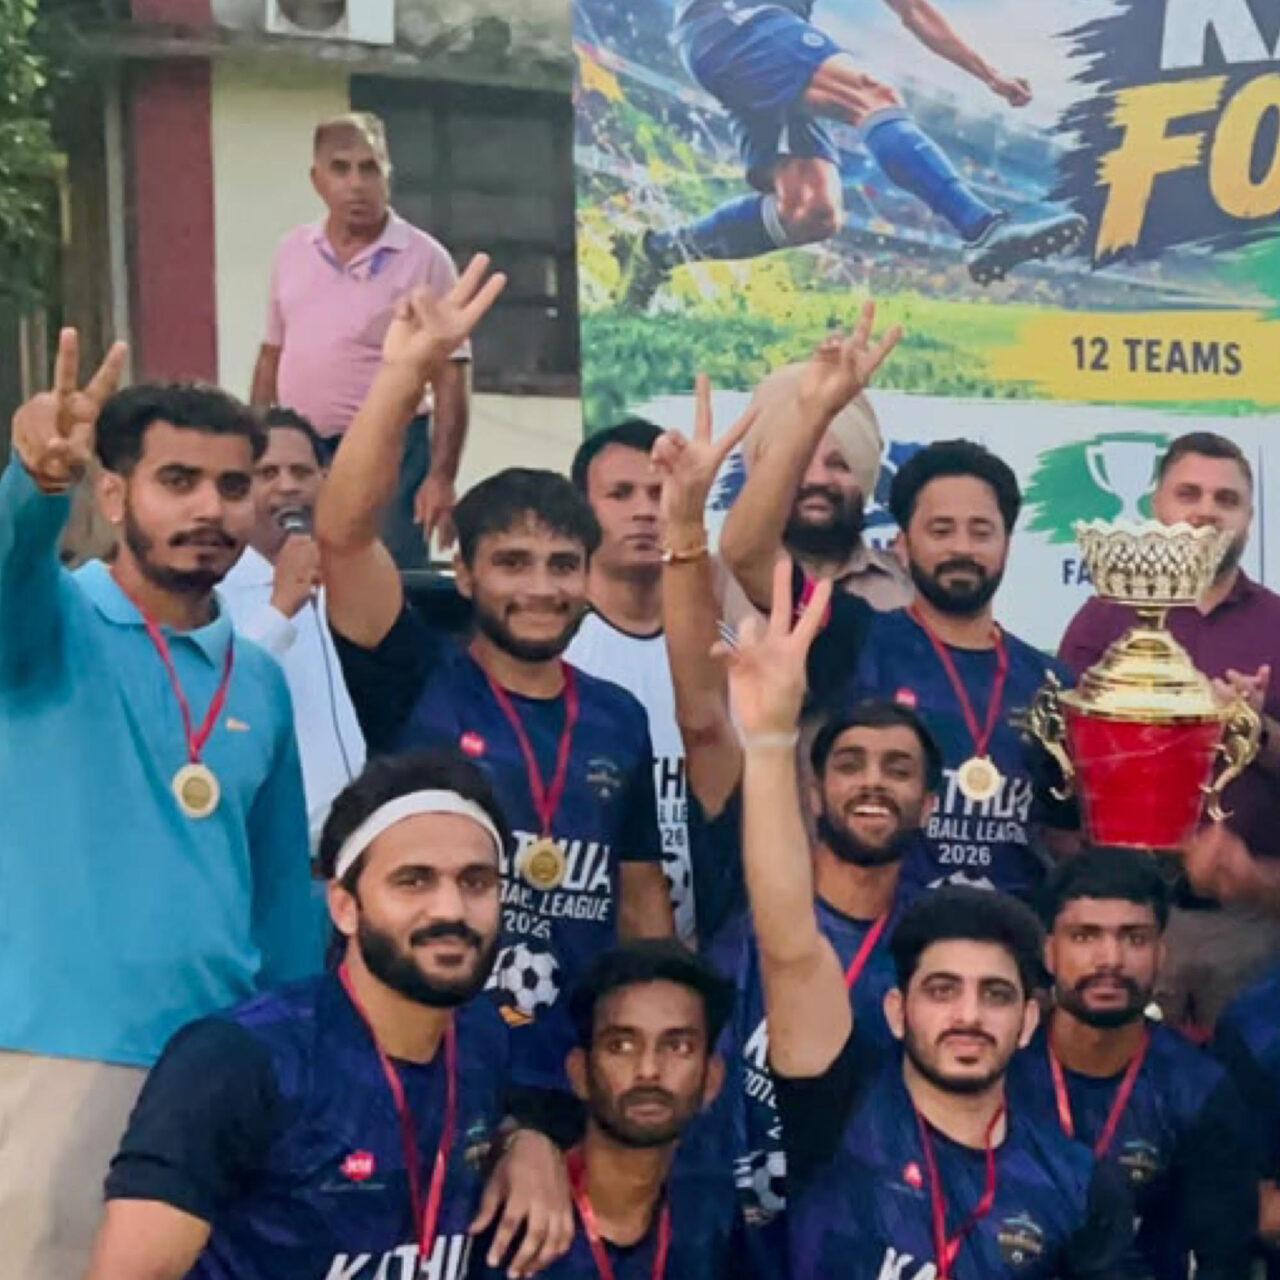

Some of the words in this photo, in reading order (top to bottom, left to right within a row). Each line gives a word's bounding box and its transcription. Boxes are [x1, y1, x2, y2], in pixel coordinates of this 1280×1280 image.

[1072, 336, 1109, 371] 12
[1122, 338, 1243, 376] TEAMS
[938, 844, 993, 867] 2026
